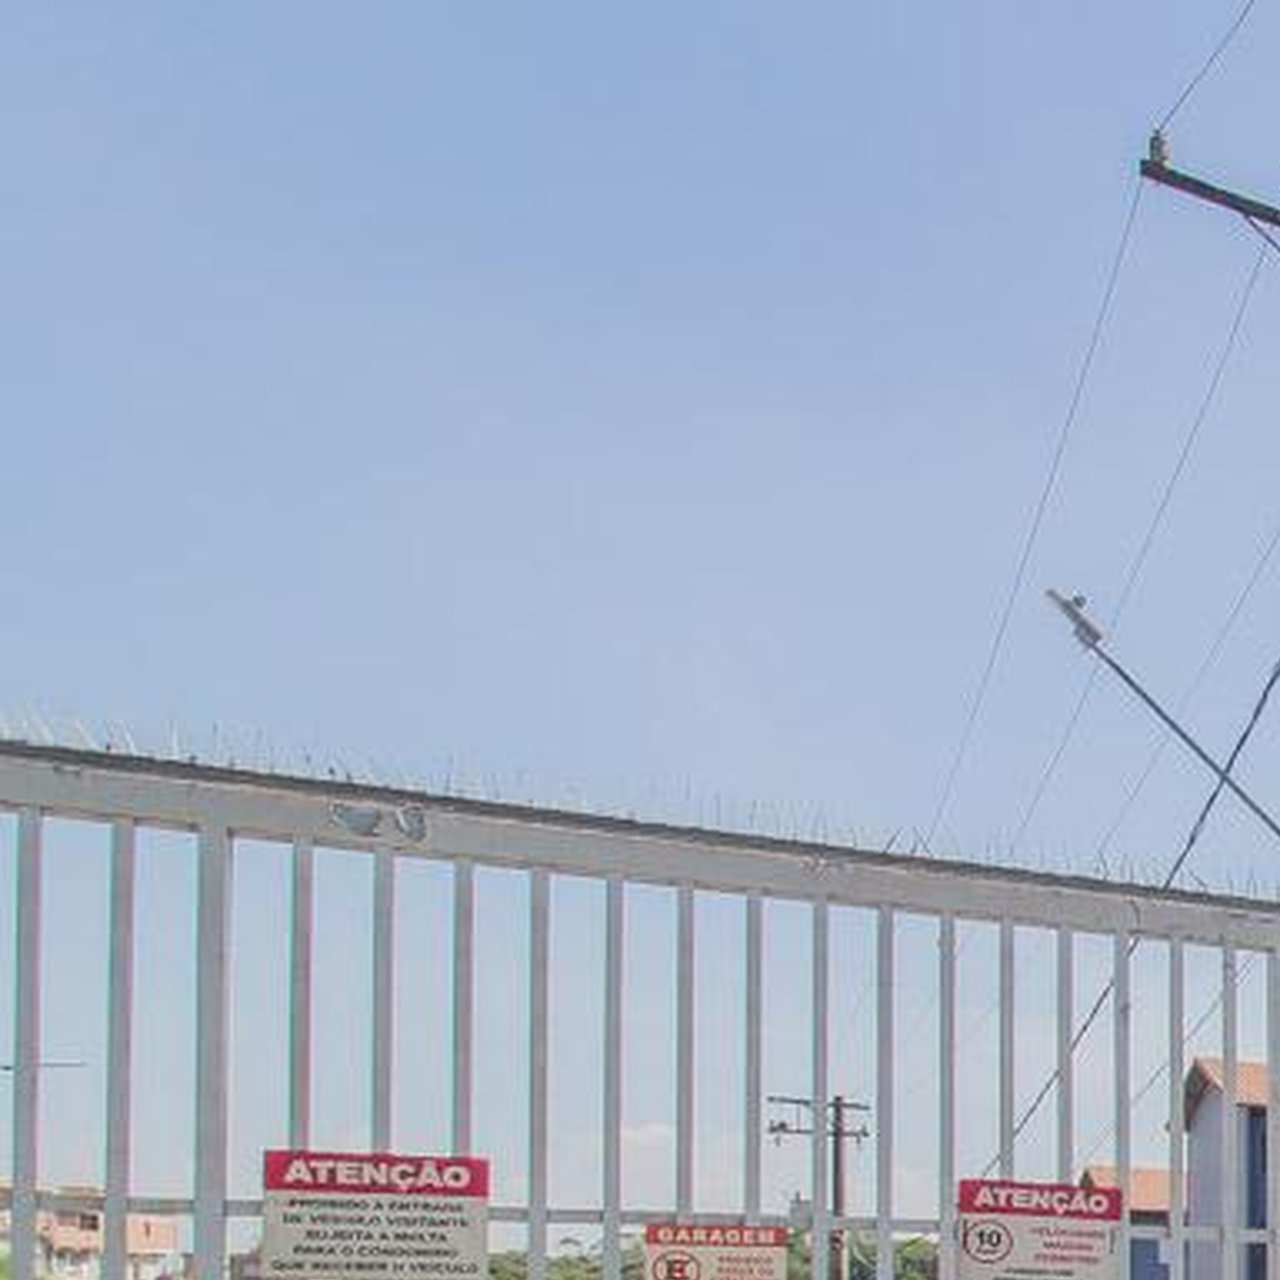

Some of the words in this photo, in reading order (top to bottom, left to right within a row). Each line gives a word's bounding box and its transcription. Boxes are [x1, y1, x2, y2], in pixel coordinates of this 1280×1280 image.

[284, 1158, 471, 1191] ATENÇÃO
[373, 1201, 384, 1211] A
[973, 1186, 1110, 1215] ATENÇÃO
[379, 1232, 390, 1242] A
[657, 1227, 776, 1245] GARAGEM
[977, 1229, 1002, 1248] 10
